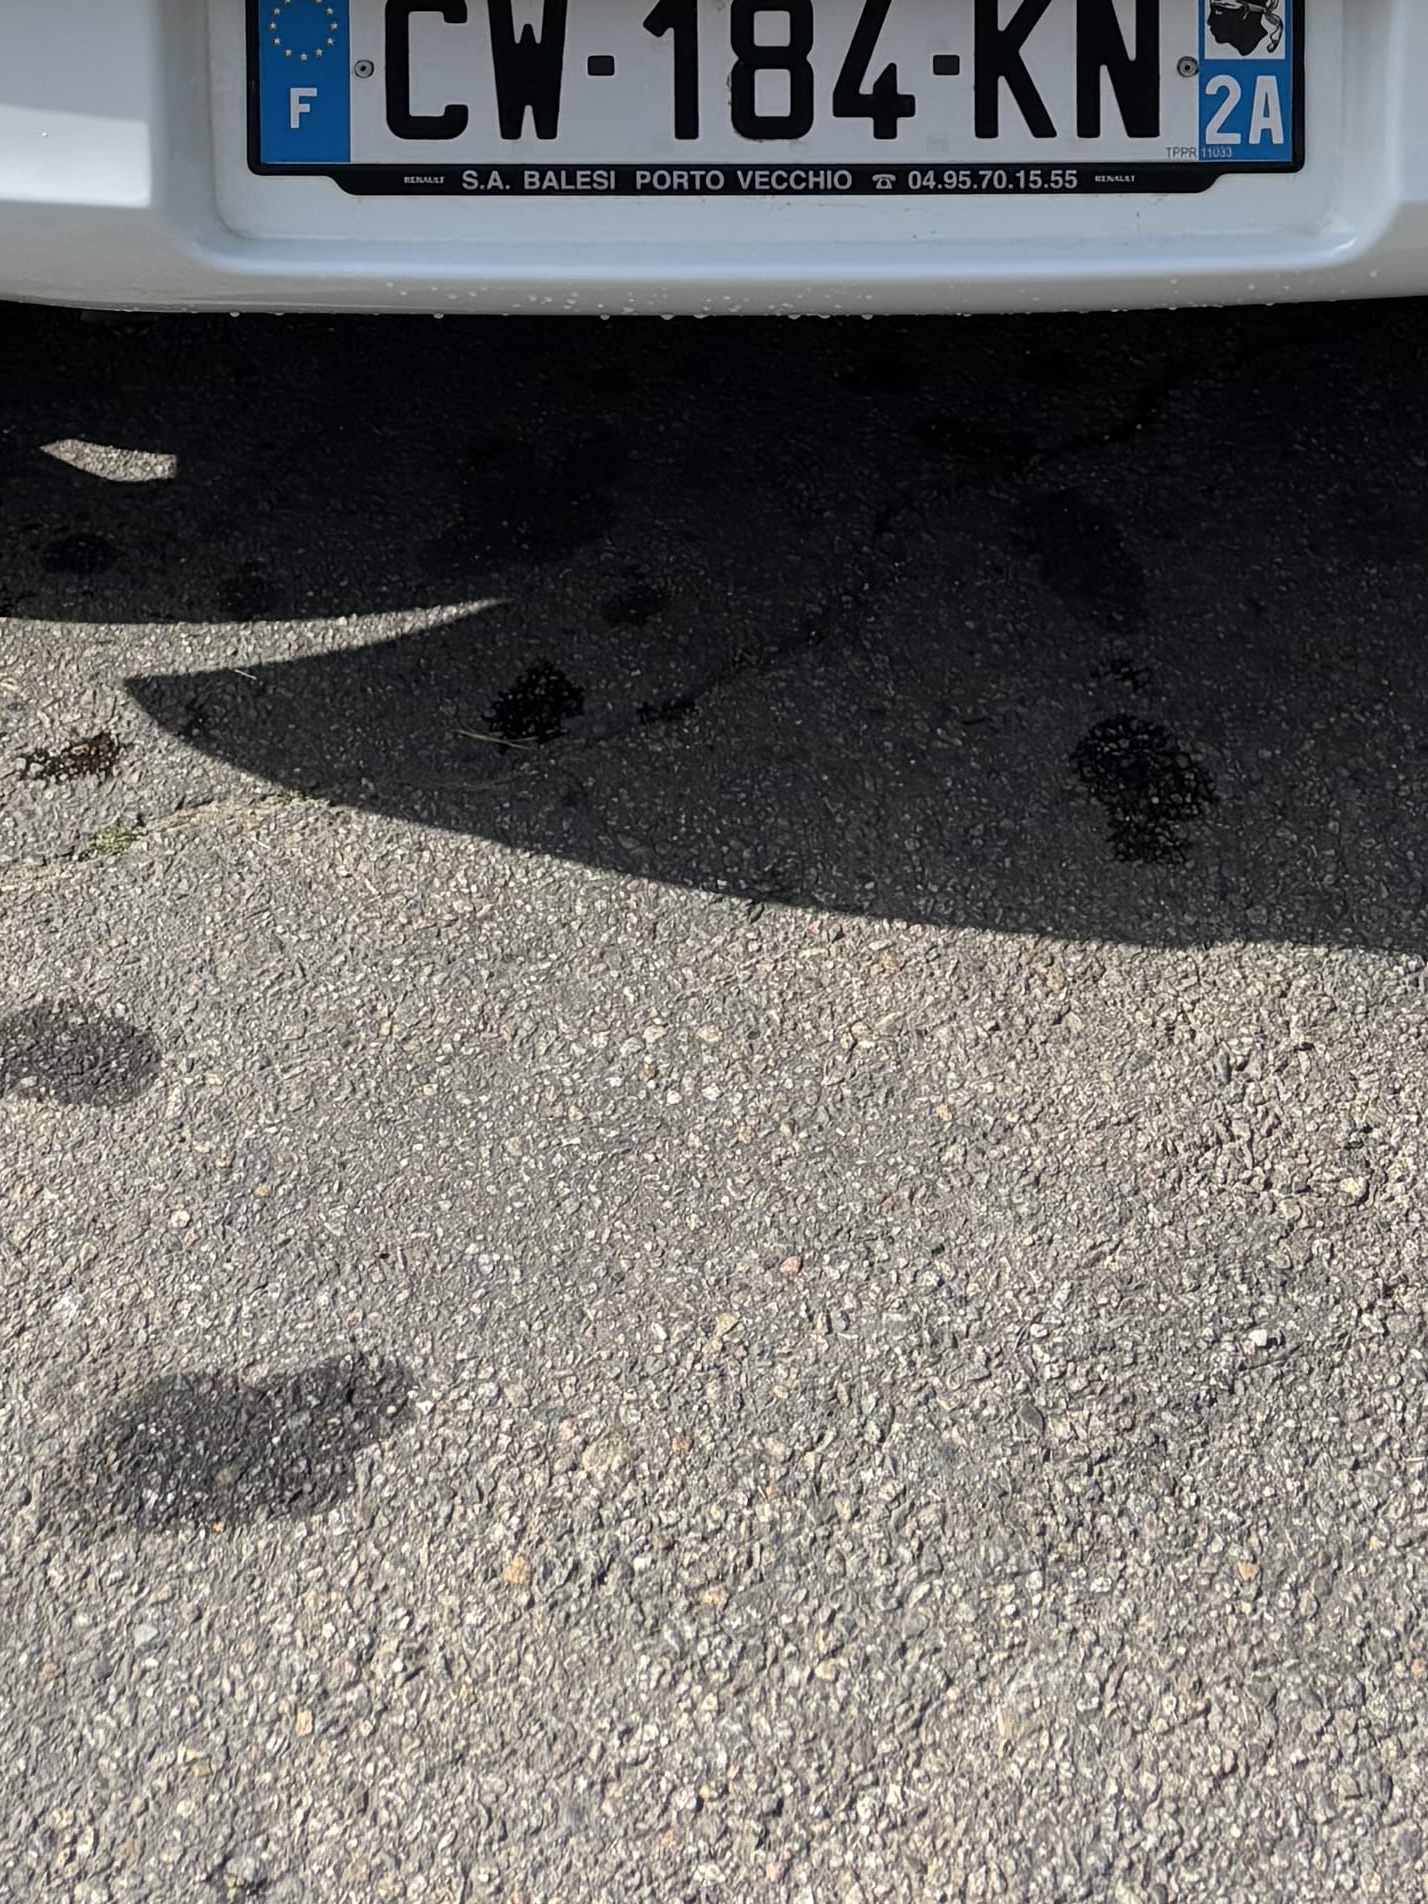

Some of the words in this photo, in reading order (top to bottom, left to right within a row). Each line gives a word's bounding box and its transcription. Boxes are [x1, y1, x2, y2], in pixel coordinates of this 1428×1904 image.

[290, 87, 318, 129] F
[1205, 74, 1285, 145] 2A
[404, 175, 445, 184] RENAULT
[462, 169, 510, 190] S.A.
[523, 169, 616, 190] BALESI
[635, 169, 725, 191] PORTO
[736, 169, 853, 191] VECCHIO
[908, 169, 1078, 190] 04.95.70.15.55
[1095, 174, 1136, 184] RENAULT
